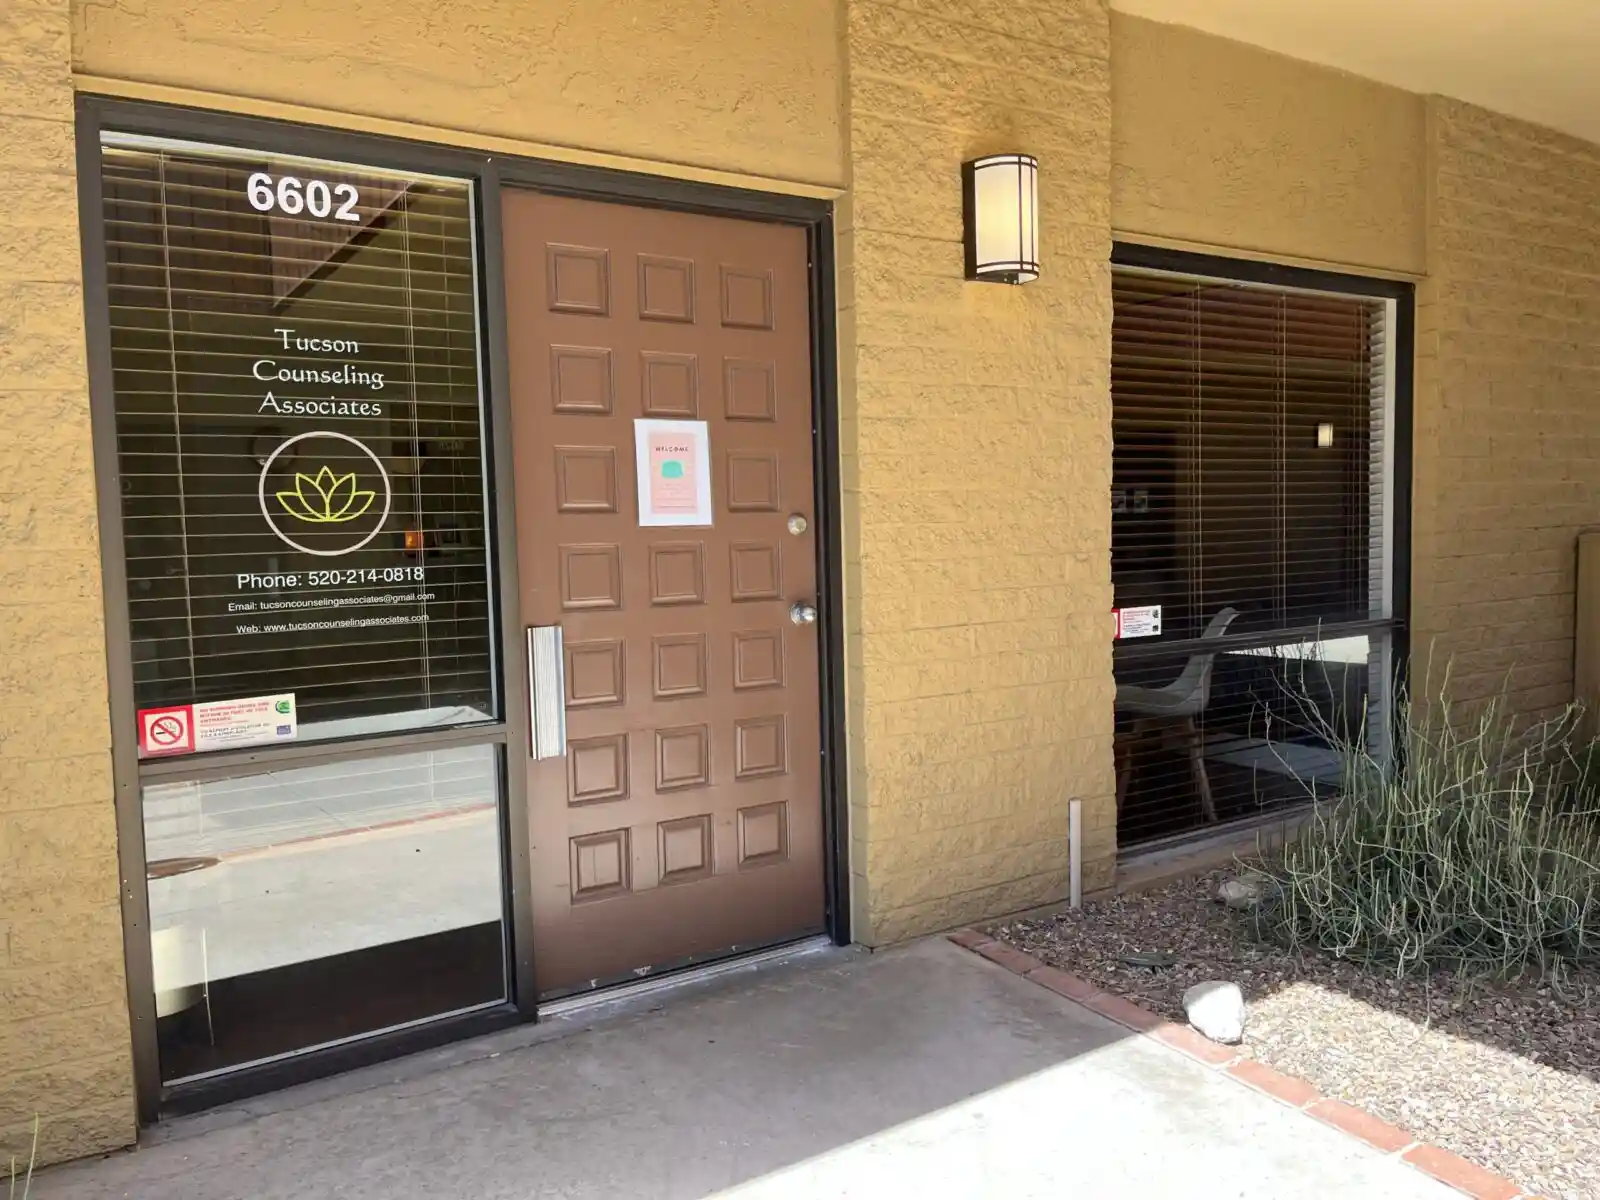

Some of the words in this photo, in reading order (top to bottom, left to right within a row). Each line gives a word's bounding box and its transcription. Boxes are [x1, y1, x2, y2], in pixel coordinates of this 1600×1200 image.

[247, 172, 361, 221] 6602
[274, 328, 360, 354] Tucson
[252, 360, 385, 390] Counseling
[258, 391, 382, 417] Associates
[237, 572, 303, 589] Phone:
[308, 567, 424, 586] 520-214-0818
[228, 602, 258, 612] Email:
[260, 593, 435, 610] tucsoncounselingassociates@gmail.com
[236, 625, 262, 634] Web:
[264, 614, 429, 632] www.tucsoncounselingassociates.com
